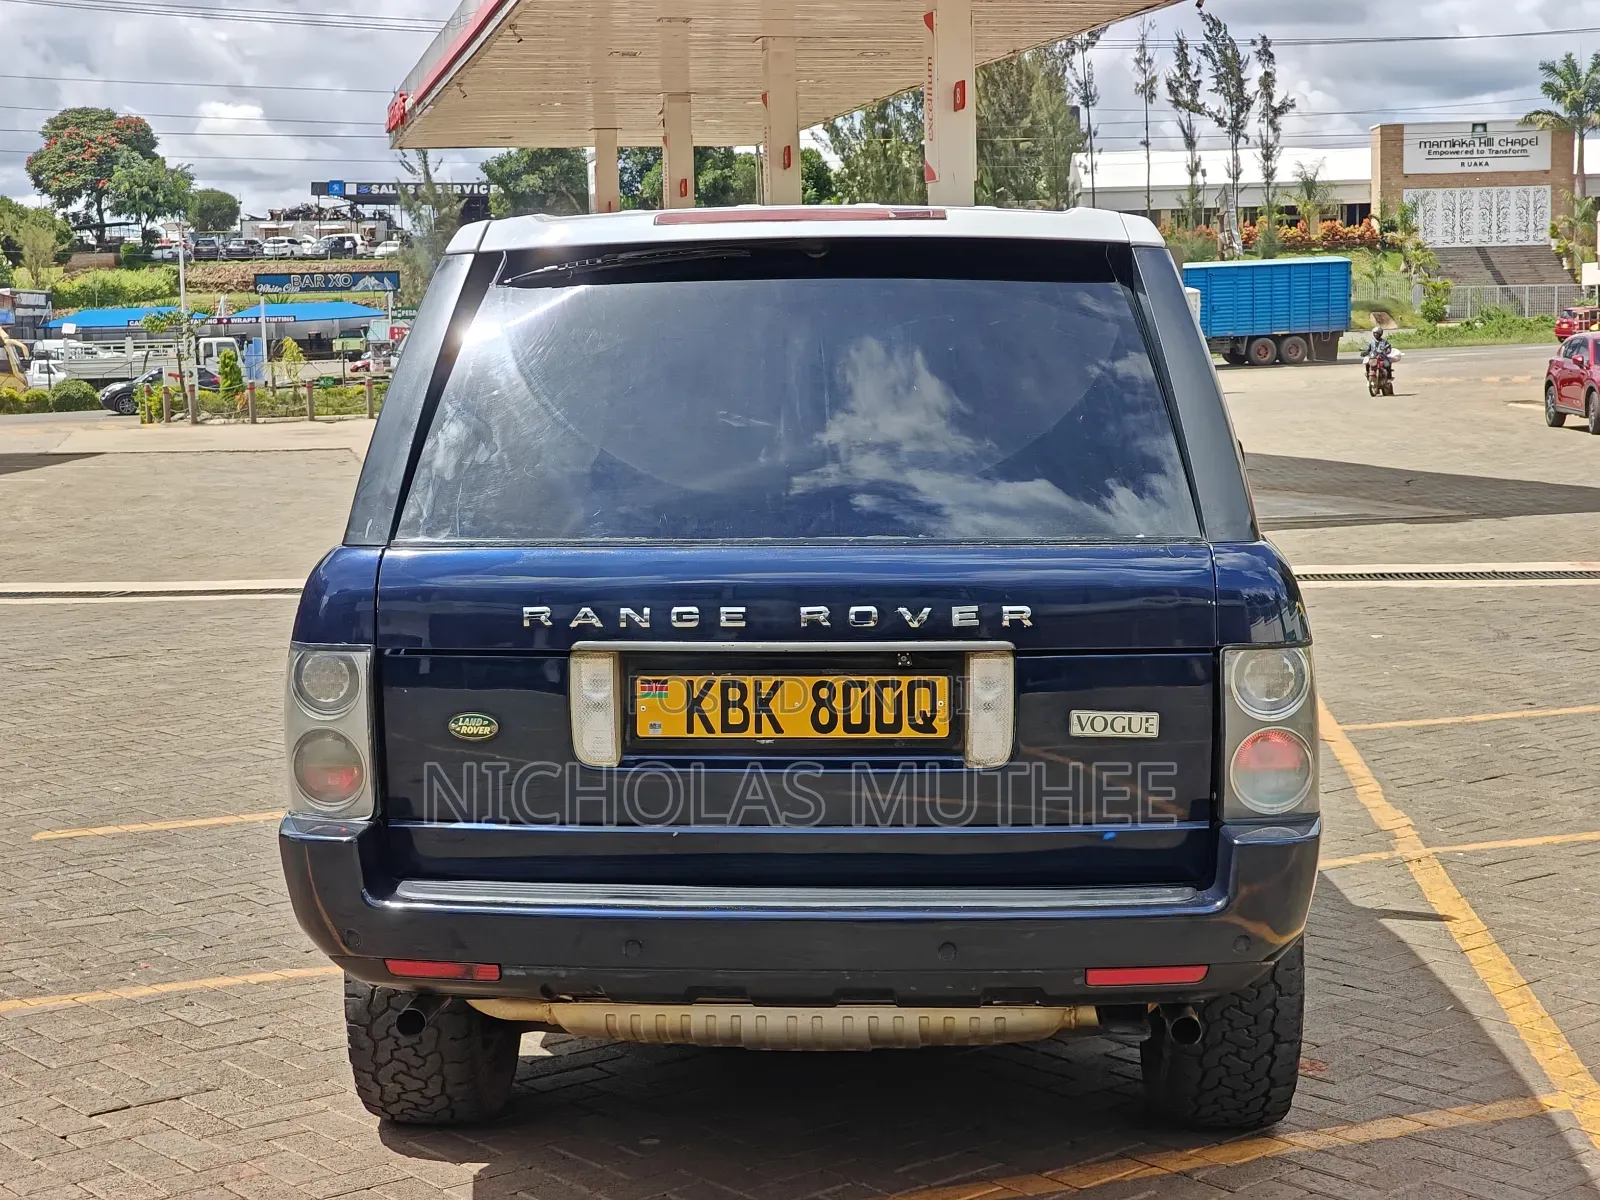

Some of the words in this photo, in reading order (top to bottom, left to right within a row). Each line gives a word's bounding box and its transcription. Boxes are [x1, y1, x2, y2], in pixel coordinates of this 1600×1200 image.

[956, 87, 961, 104] 8
[290, 274, 325, 288] BAR
[328, 273, 353, 288] XO
[230, 316, 256, 324] WRAPS
[522, 605, 746, 628] RANGE
[800, 604, 1033, 628] ROVER
[686, 679, 785, 735] KBK
[810, 679, 938, 735] 800Q
[458, 717, 483, 726] LAND
[460, 725, 491, 734] ROVER
[1076, 715, 1154, 734] VOGUE
